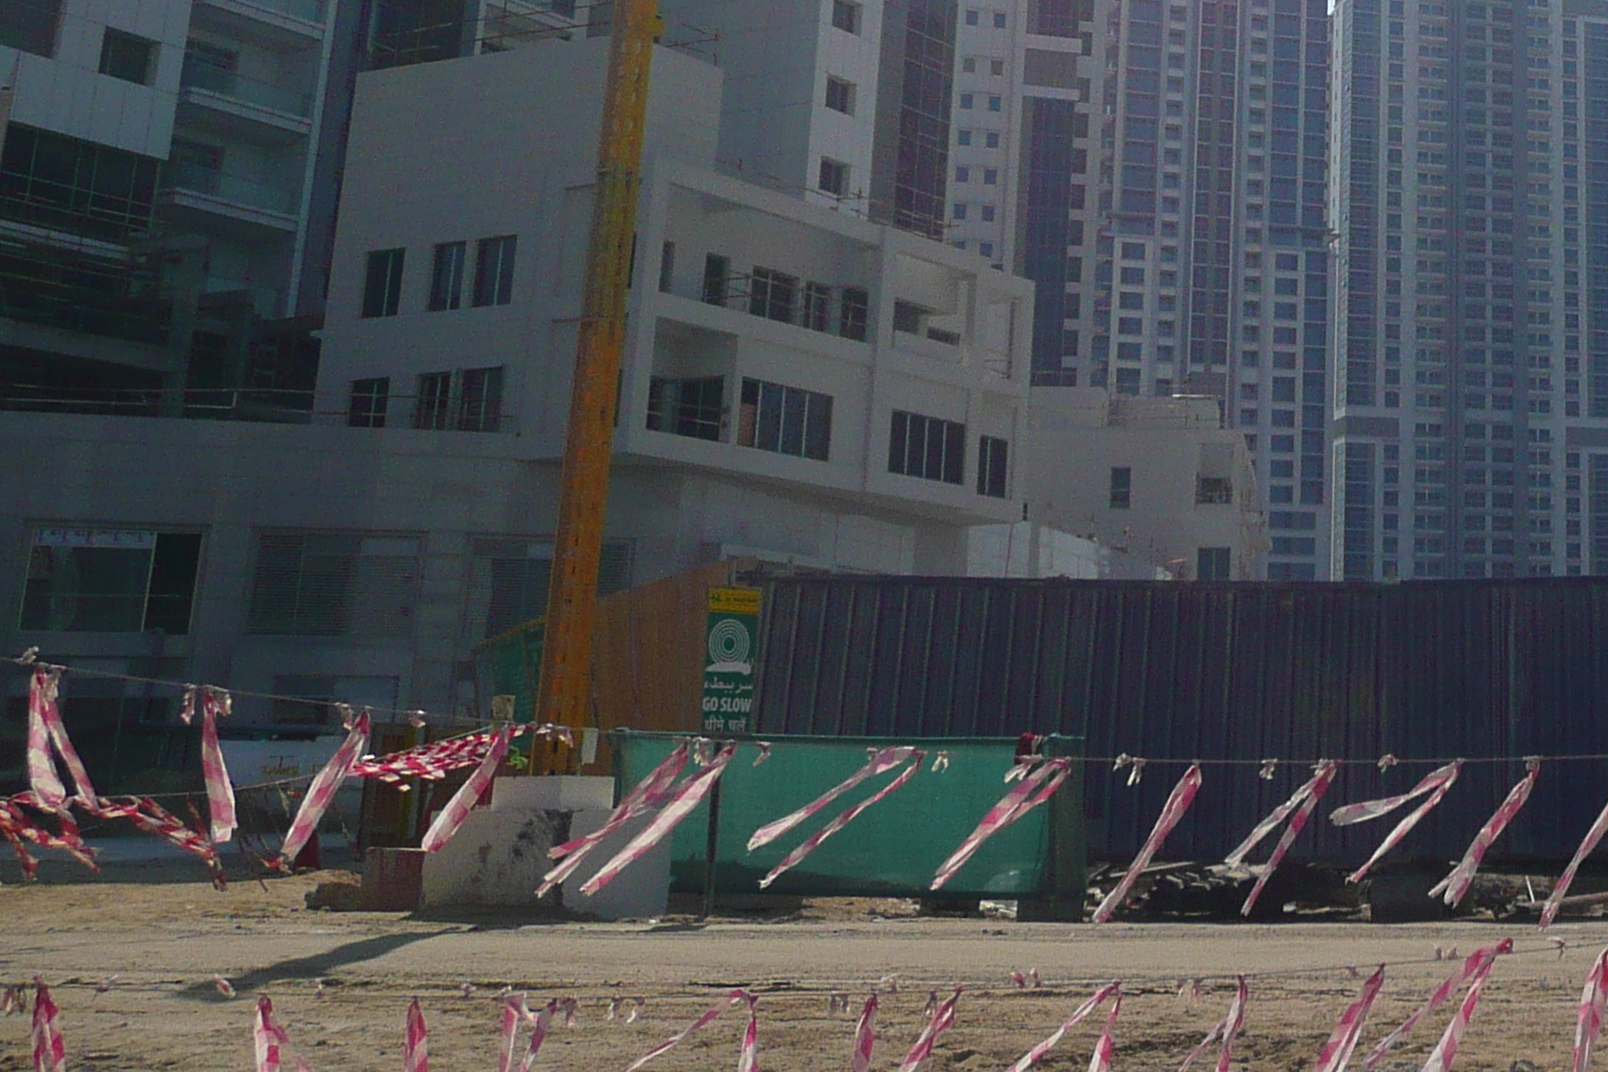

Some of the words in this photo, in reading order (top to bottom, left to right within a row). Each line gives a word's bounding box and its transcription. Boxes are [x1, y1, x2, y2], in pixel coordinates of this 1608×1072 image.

[704, 676, 735, 694] ببطء
[735, 682, 754, 694] سر
[702, 696, 719, 712] GO
[719, 697, 753, 713] SLOW
